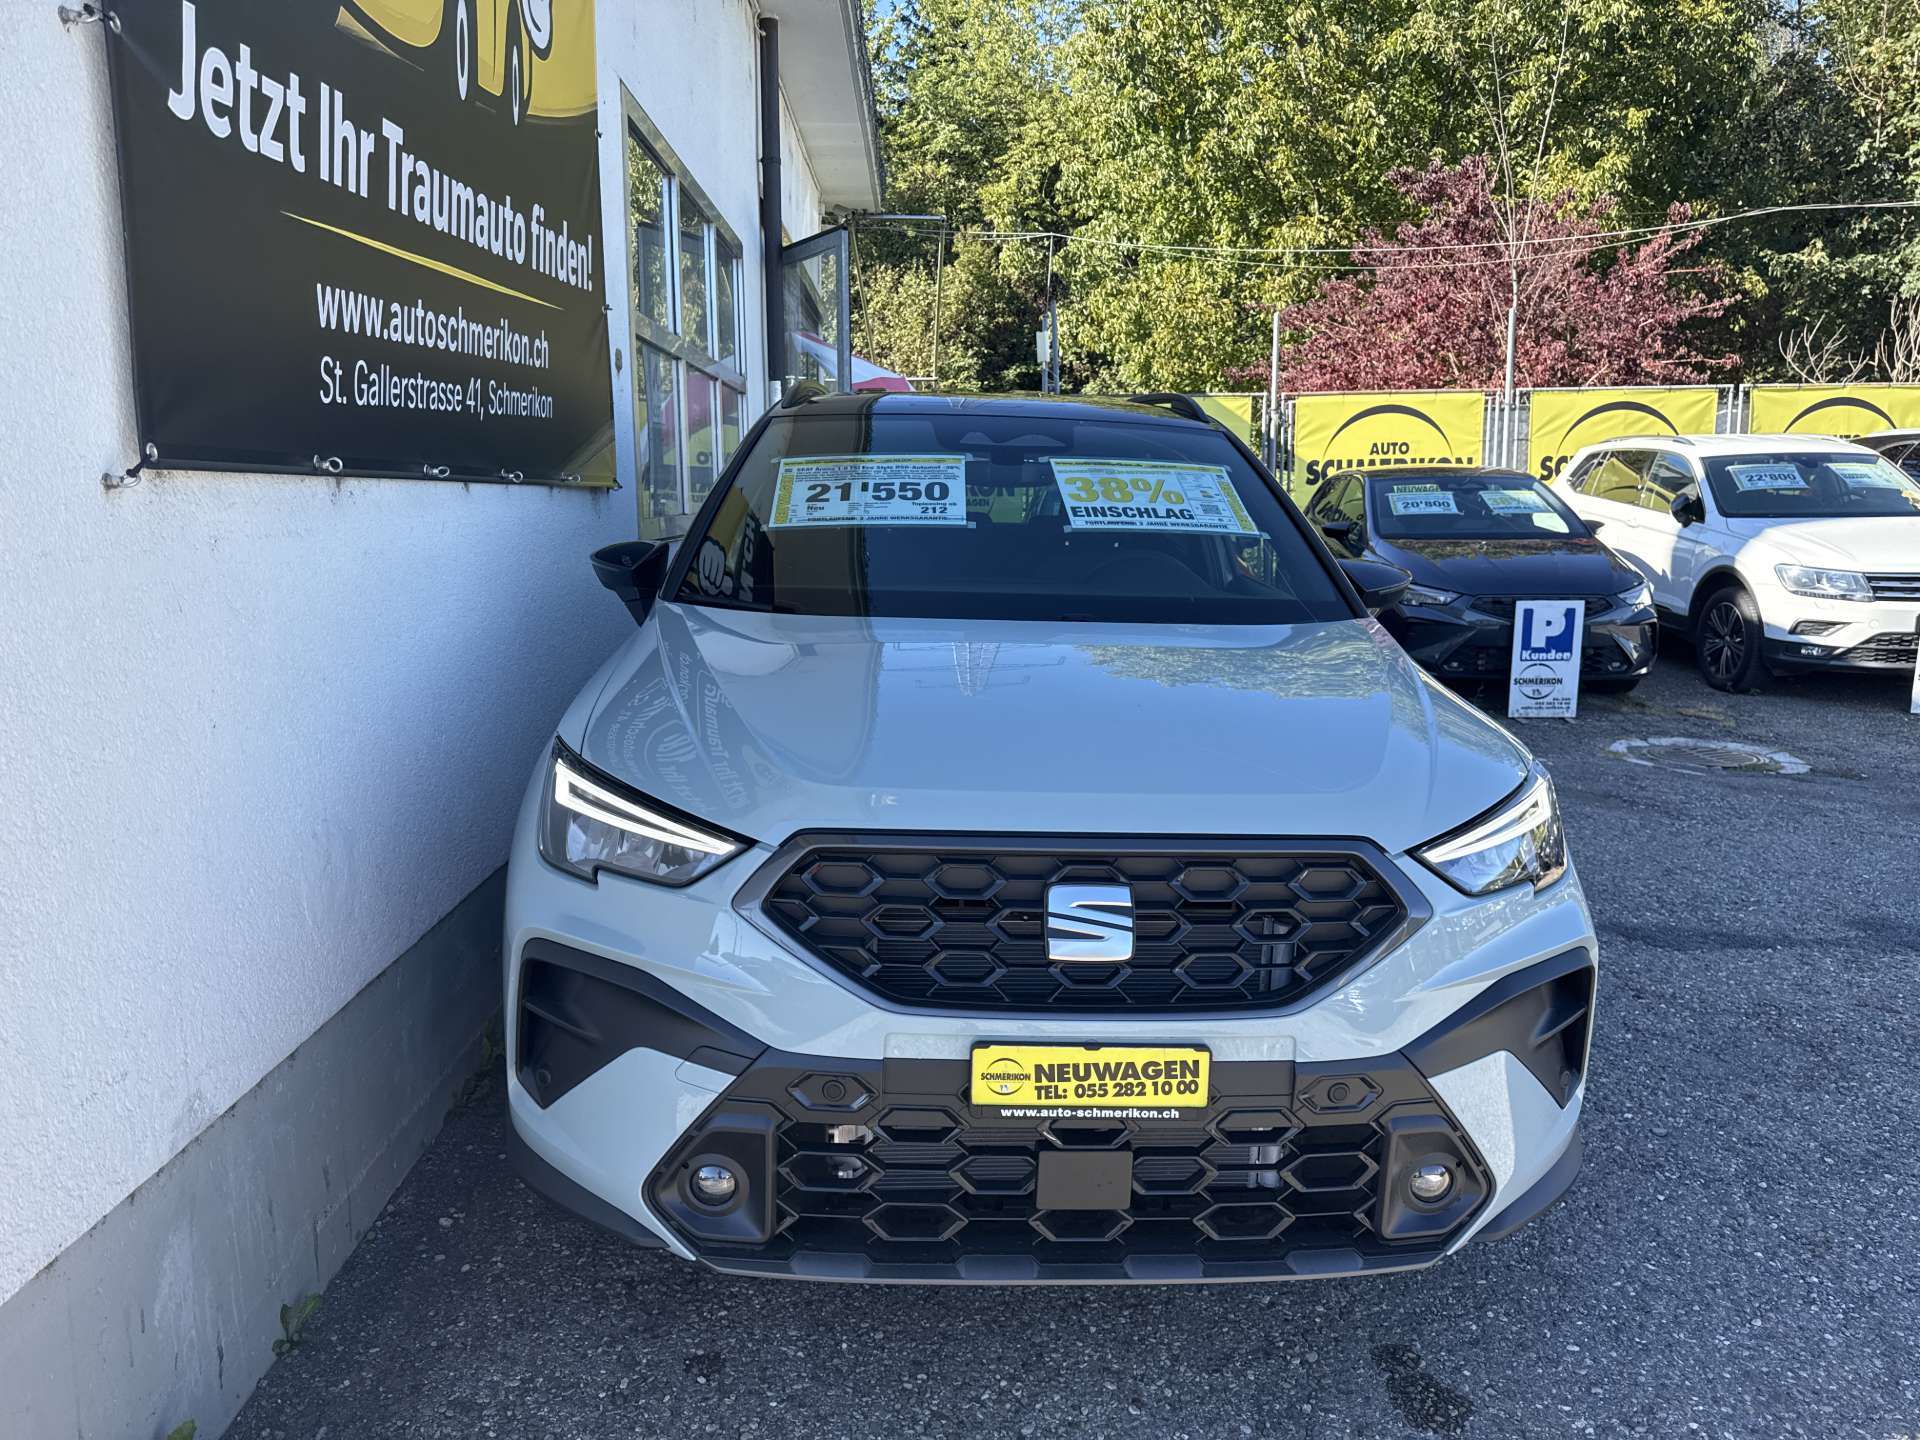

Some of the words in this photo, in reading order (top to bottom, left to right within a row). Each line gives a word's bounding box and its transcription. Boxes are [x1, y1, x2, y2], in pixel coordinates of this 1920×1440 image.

[168, 0, 306, 173] Jetzt
[319, 81, 375, 200] Ihr
[381, 116, 526, 266] Traumauto
[530, 203, 594, 292] finden!
[316, 282, 550, 370] www.autoschmerikon.ch
[319, 355, 347, 405] St.
[353, 359, 463, 413] Gallerstrasse
[466, 377, 485, 423] 41,
[488, 386, 554, 419] Schmerikon
[1369, 442, 1410, 455] AUTO
[805, 481, 950, 502] 21'550
[1063, 477, 1185, 505] 38%
[920, 506, 948, 514] 212
[1070, 506, 1195, 520] EINSCHLAG
[1521, 650, 1572, 661] Kunden
[1514, 677, 1563, 686] SCHMERIKON
[980, 1072, 1031, 1082] SCHMERIKON
[1034, 1060, 1200, 1083] NEUWAGEN
[1074, 1083, 1108, 1099] 055
[1112, 1082, 1146, 1098] 282
[1151, 1081, 1172, 1096] 10
[1176, 1080, 1199, 1095] 00
[1000, 1109, 1180, 1119] www.auto-schmerikon.ch
